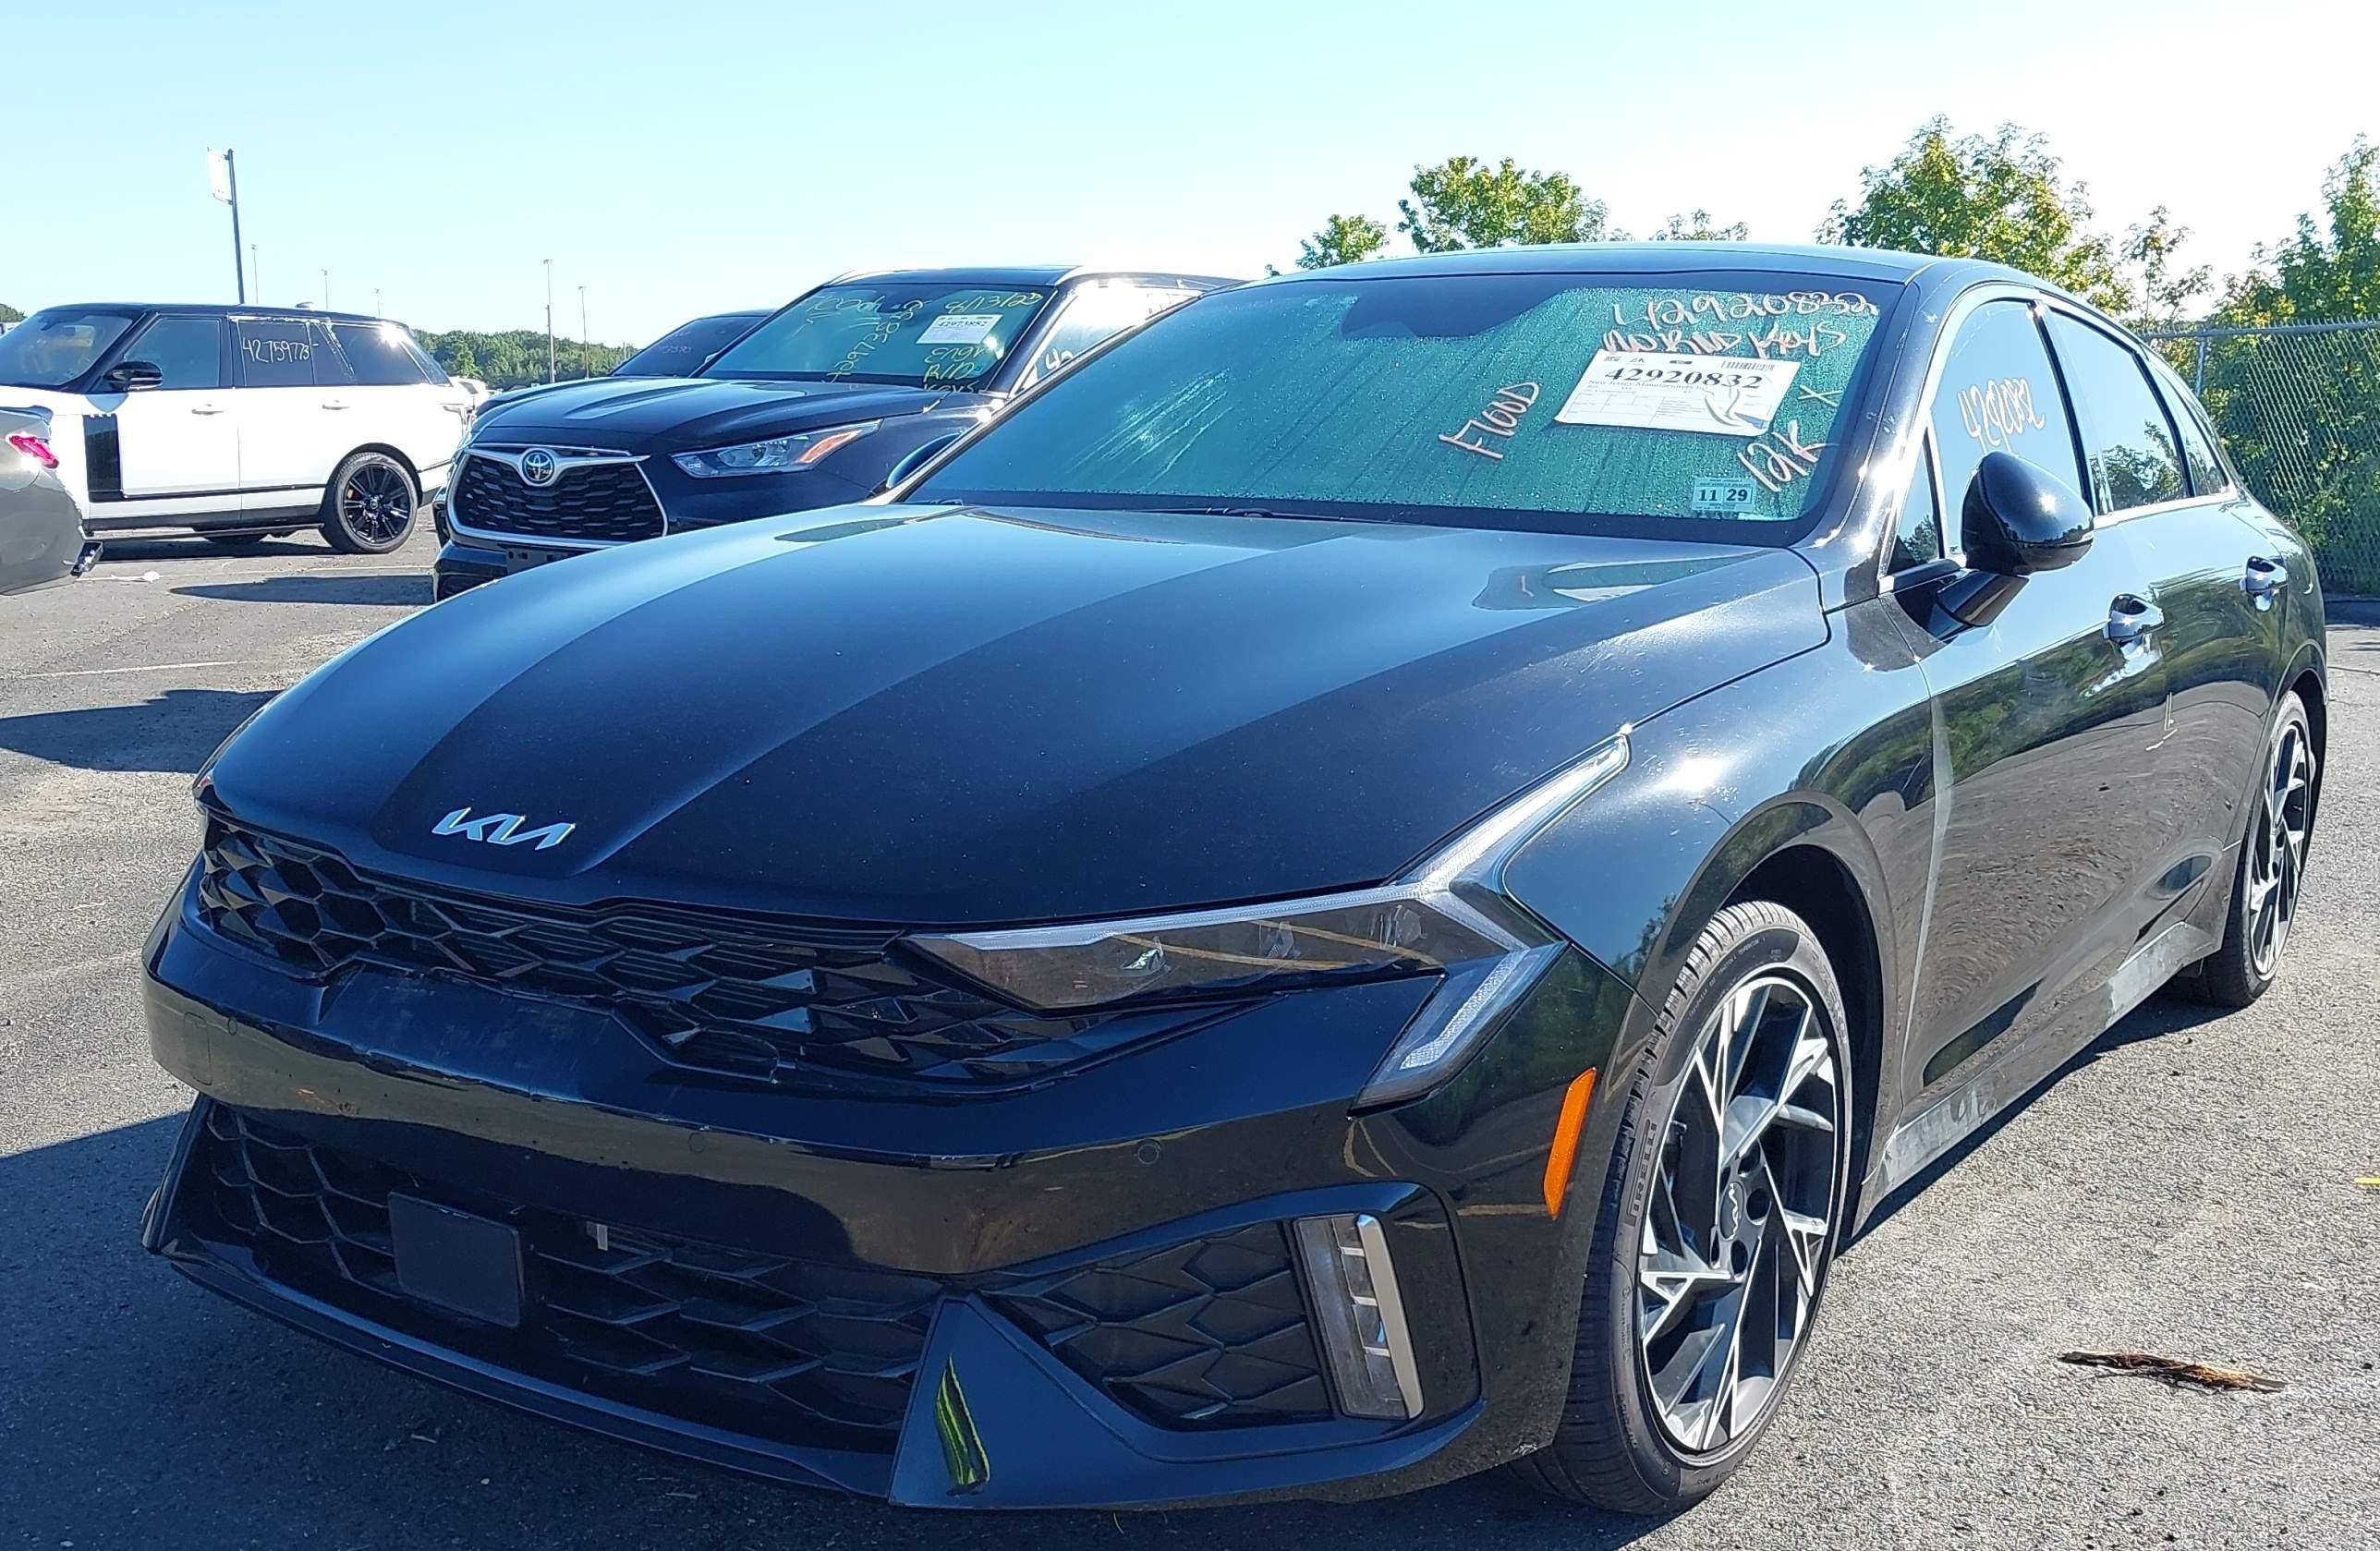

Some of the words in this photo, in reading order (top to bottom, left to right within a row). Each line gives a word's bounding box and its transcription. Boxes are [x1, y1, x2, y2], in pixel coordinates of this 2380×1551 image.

[1604, 367, 1763, 389] 42920832
[1698, 489, 1718, 502] 11
[1726, 488, 1748, 502] 29
[431, 806, 577, 851] KIA
